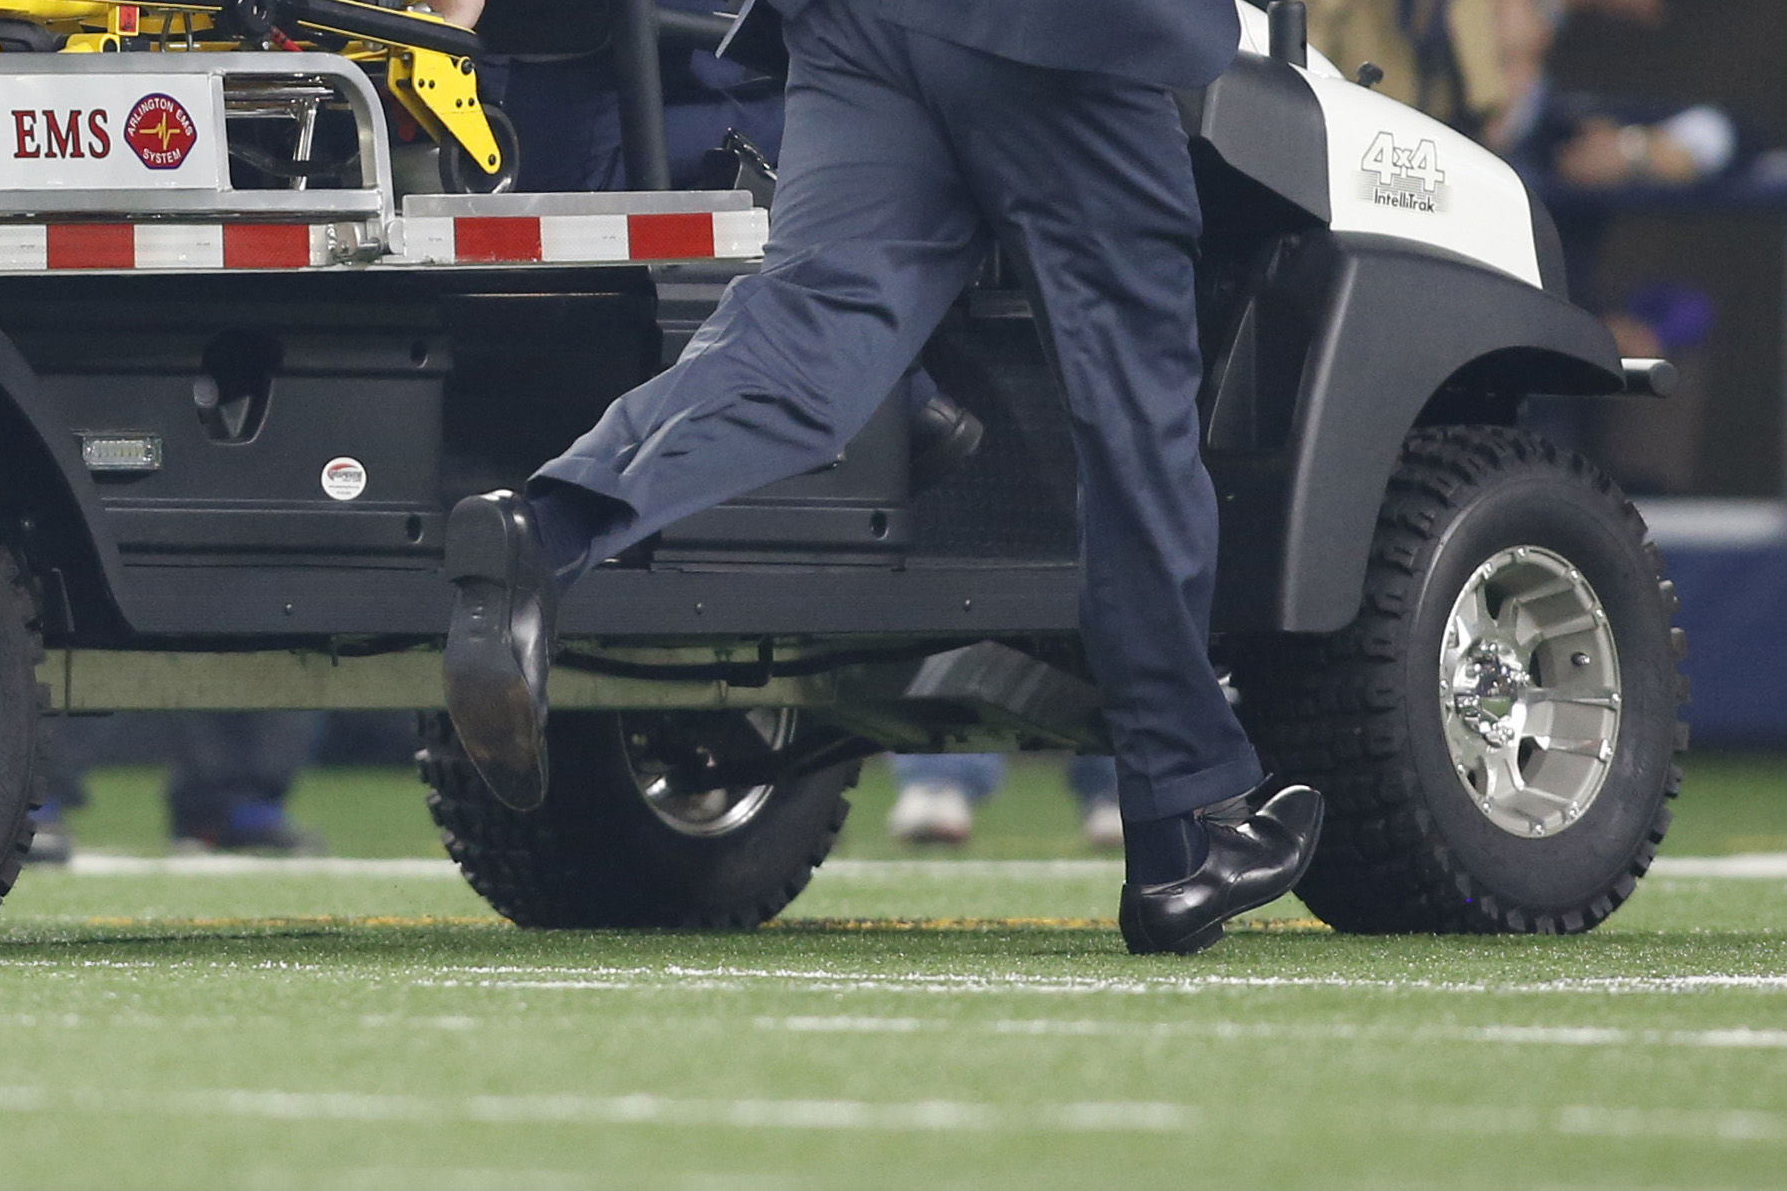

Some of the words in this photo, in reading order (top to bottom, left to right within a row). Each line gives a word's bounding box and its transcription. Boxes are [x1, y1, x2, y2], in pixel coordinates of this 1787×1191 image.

[11, 109, 111, 159] EMS
[128, 98, 174, 137] ARLINGTON
[175, 109, 193, 136] EMS
[142, 148, 181, 164] SYSTEM
[1361, 131, 1445, 193] 4x4
[1374, 188, 1435, 213] IntelliTrak
